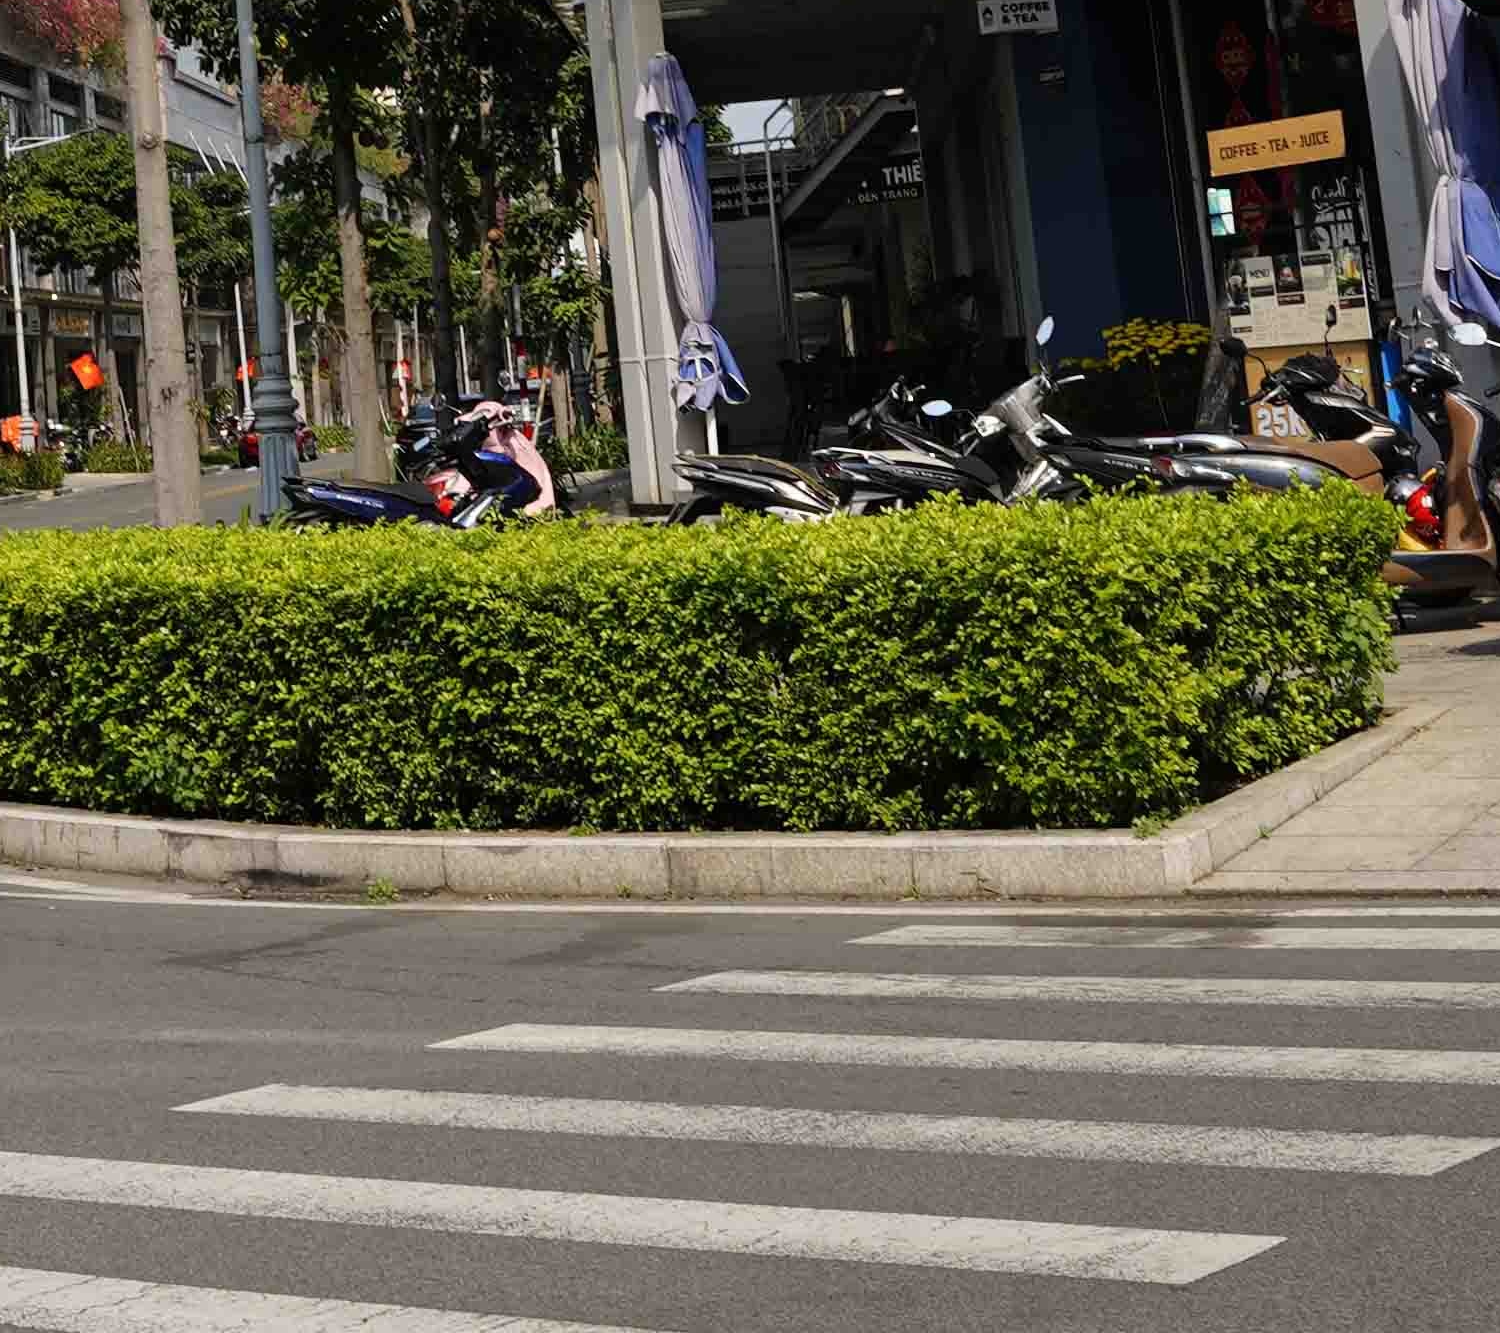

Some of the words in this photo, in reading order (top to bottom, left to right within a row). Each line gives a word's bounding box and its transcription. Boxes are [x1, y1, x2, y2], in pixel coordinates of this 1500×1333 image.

[1001, 1, 1051, 14] COFFEE
[1014, 12, 1039, 24] TEA
[1219, 142, 1258, 160] COFFEE
[1268, 137, 1290, 153] TEA
[1299, 131, 1330, 148] JUICE
